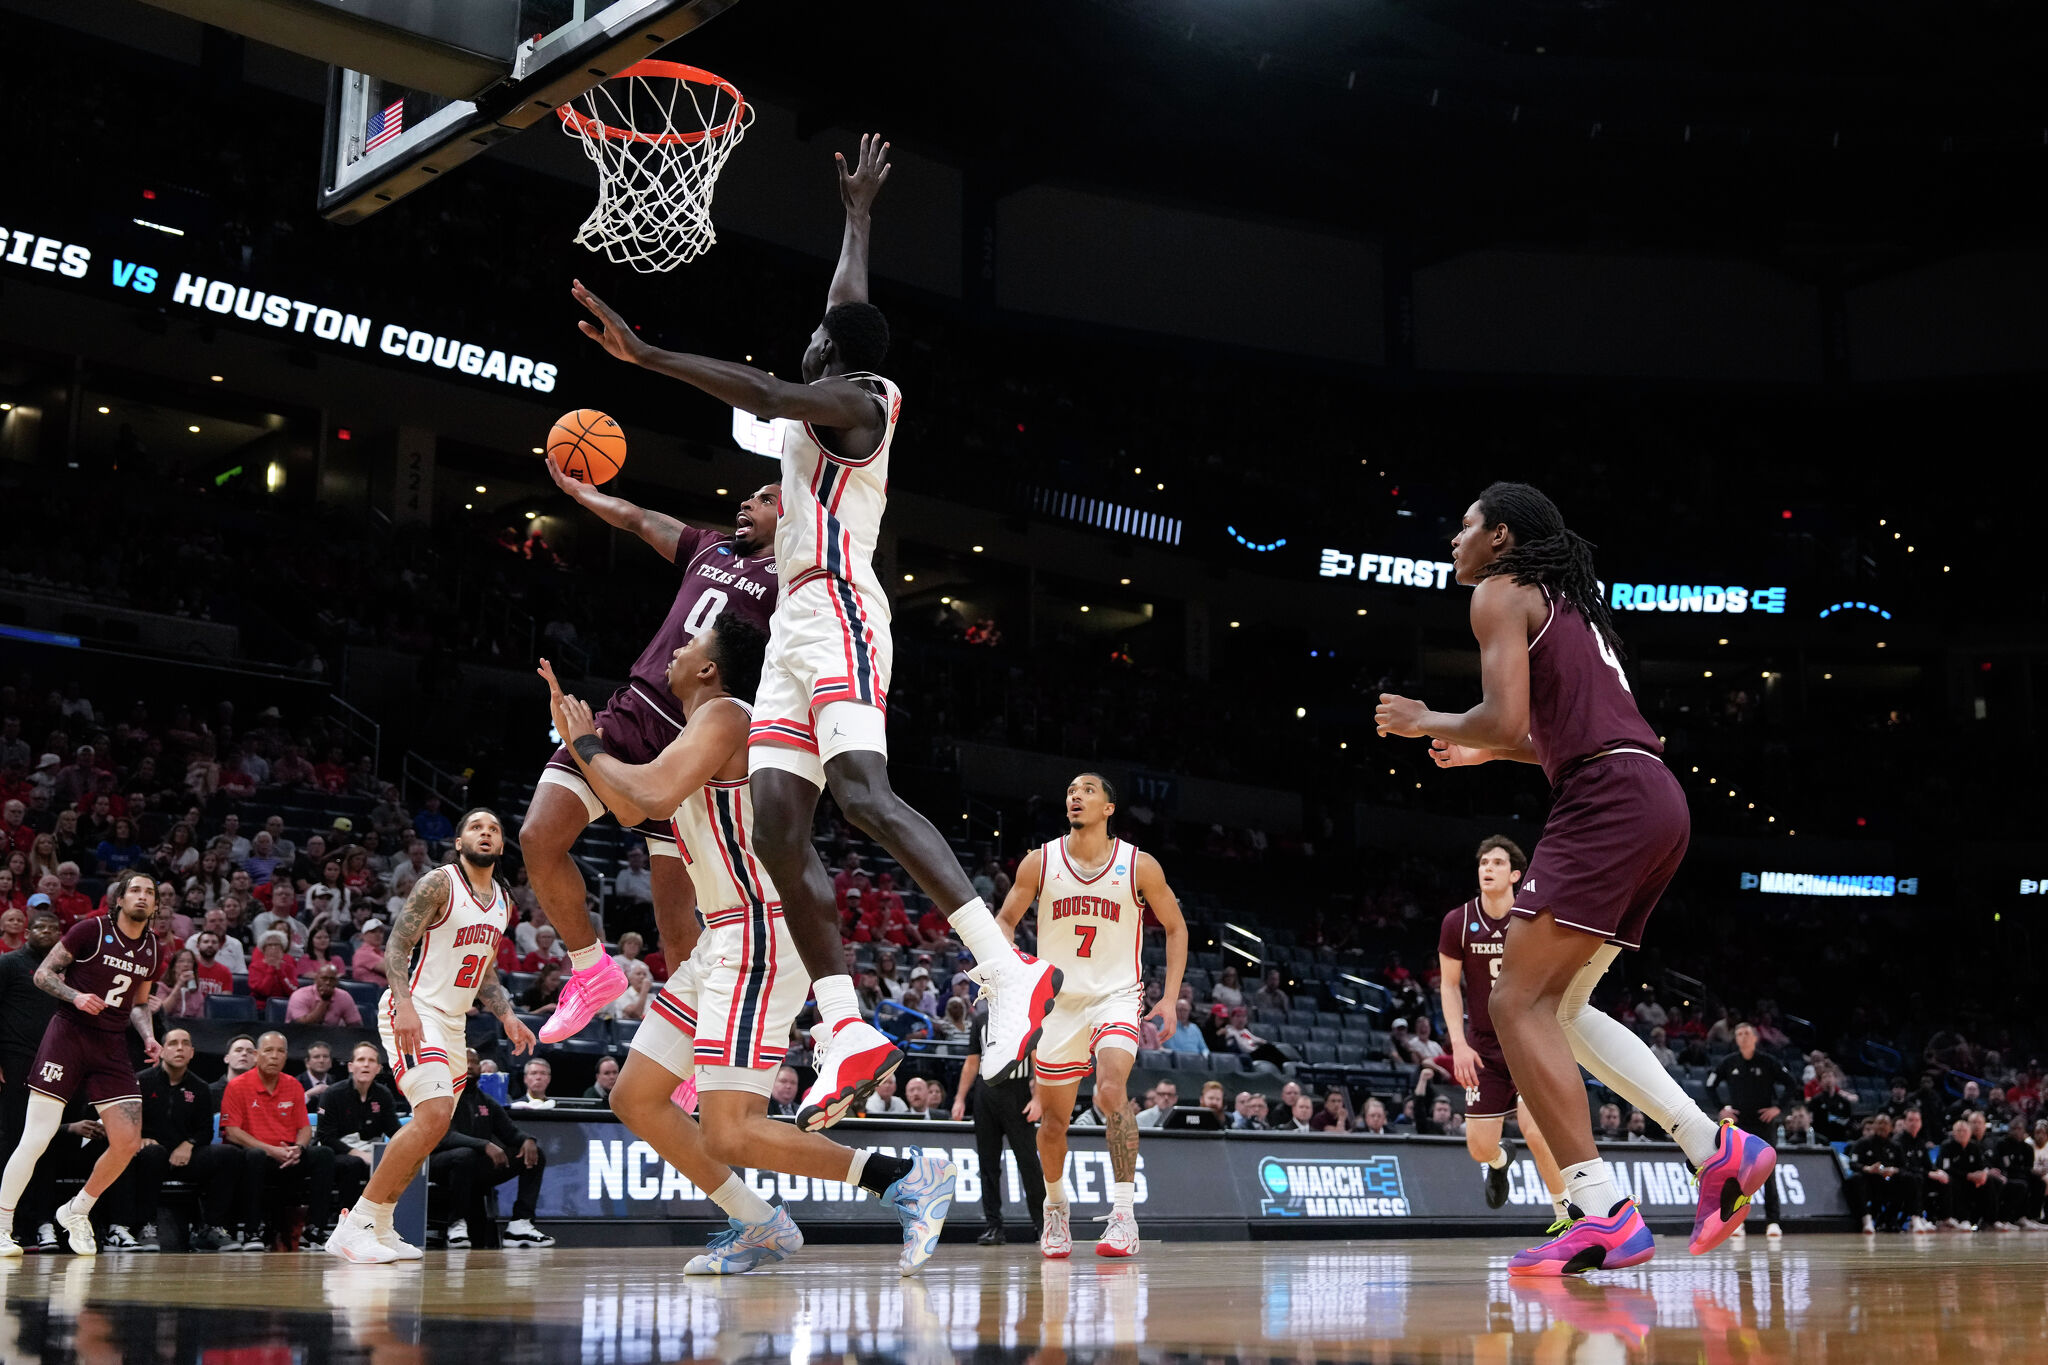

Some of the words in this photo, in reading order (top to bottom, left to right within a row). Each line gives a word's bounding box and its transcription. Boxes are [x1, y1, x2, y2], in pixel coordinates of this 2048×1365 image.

[112, 259, 158, 294] VS
[172, 272, 372, 348] HOUSTON
[380, 323, 558, 393] COUGARS
[696, 563, 737, 585] TEXAS
[733, 576, 767, 601] A&M
[1358, 552, 1454, 590] FIRST
[683, 587, 729, 638] 0
[1611, 582, 1749, 614] ROUNDS
[1136, 776, 1169, 801] 117
[1760, 871, 1896, 896] MARCHMADNESS
[1052, 895, 1121, 923] HOUSTON
[453, 923, 503, 951] HOUSTO
[1074, 924, 1097, 958] 7
[1470, 942, 1504, 955] TEXAS
[103, 954, 133, 973] TEXAS
[454, 954, 488, 988] 21
[104, 973, 133, 1008] 2
[1286, 1165, 1365, 1197] MARCH
